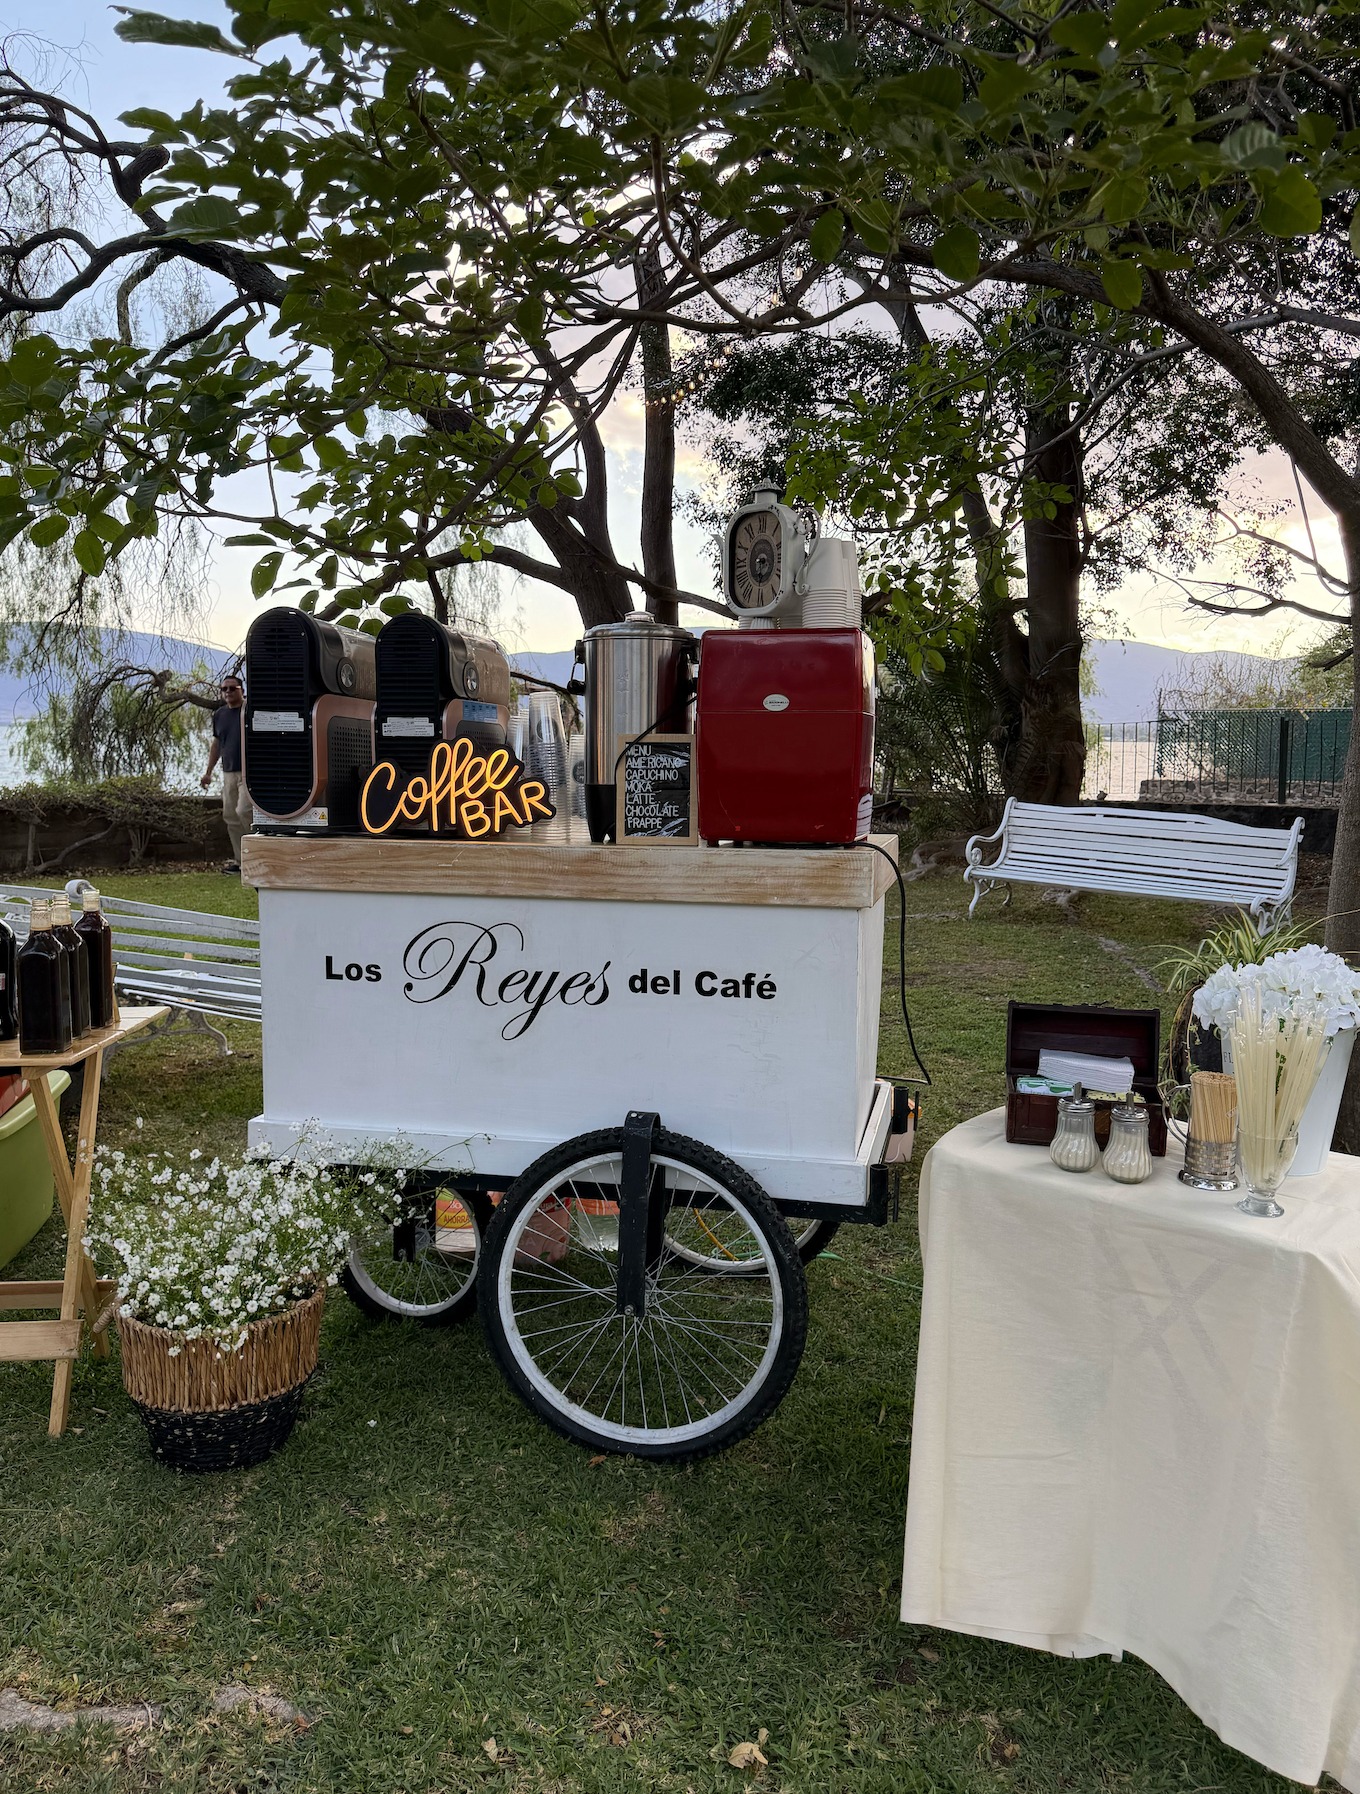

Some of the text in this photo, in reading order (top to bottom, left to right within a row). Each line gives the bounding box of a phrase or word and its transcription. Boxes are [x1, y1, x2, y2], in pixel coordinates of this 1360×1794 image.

[625, 744, 652, 756] MENU
[625, 757, 682, 769] AMERICANO
[625, 769, 679, 781] CAPUCHINO
[361, 737, 519, 834] Coffee
[625, 780, 652, 792] MOKA
[626, 793, 656, 804] LATTE
[460, 781, 552, 838] BAR
[625, 804, 679, 817] CHOCOLATE
[627, 817, 662, 829] FRAPPE
[325, 921, 778, 1041] Los Reyes del Café
